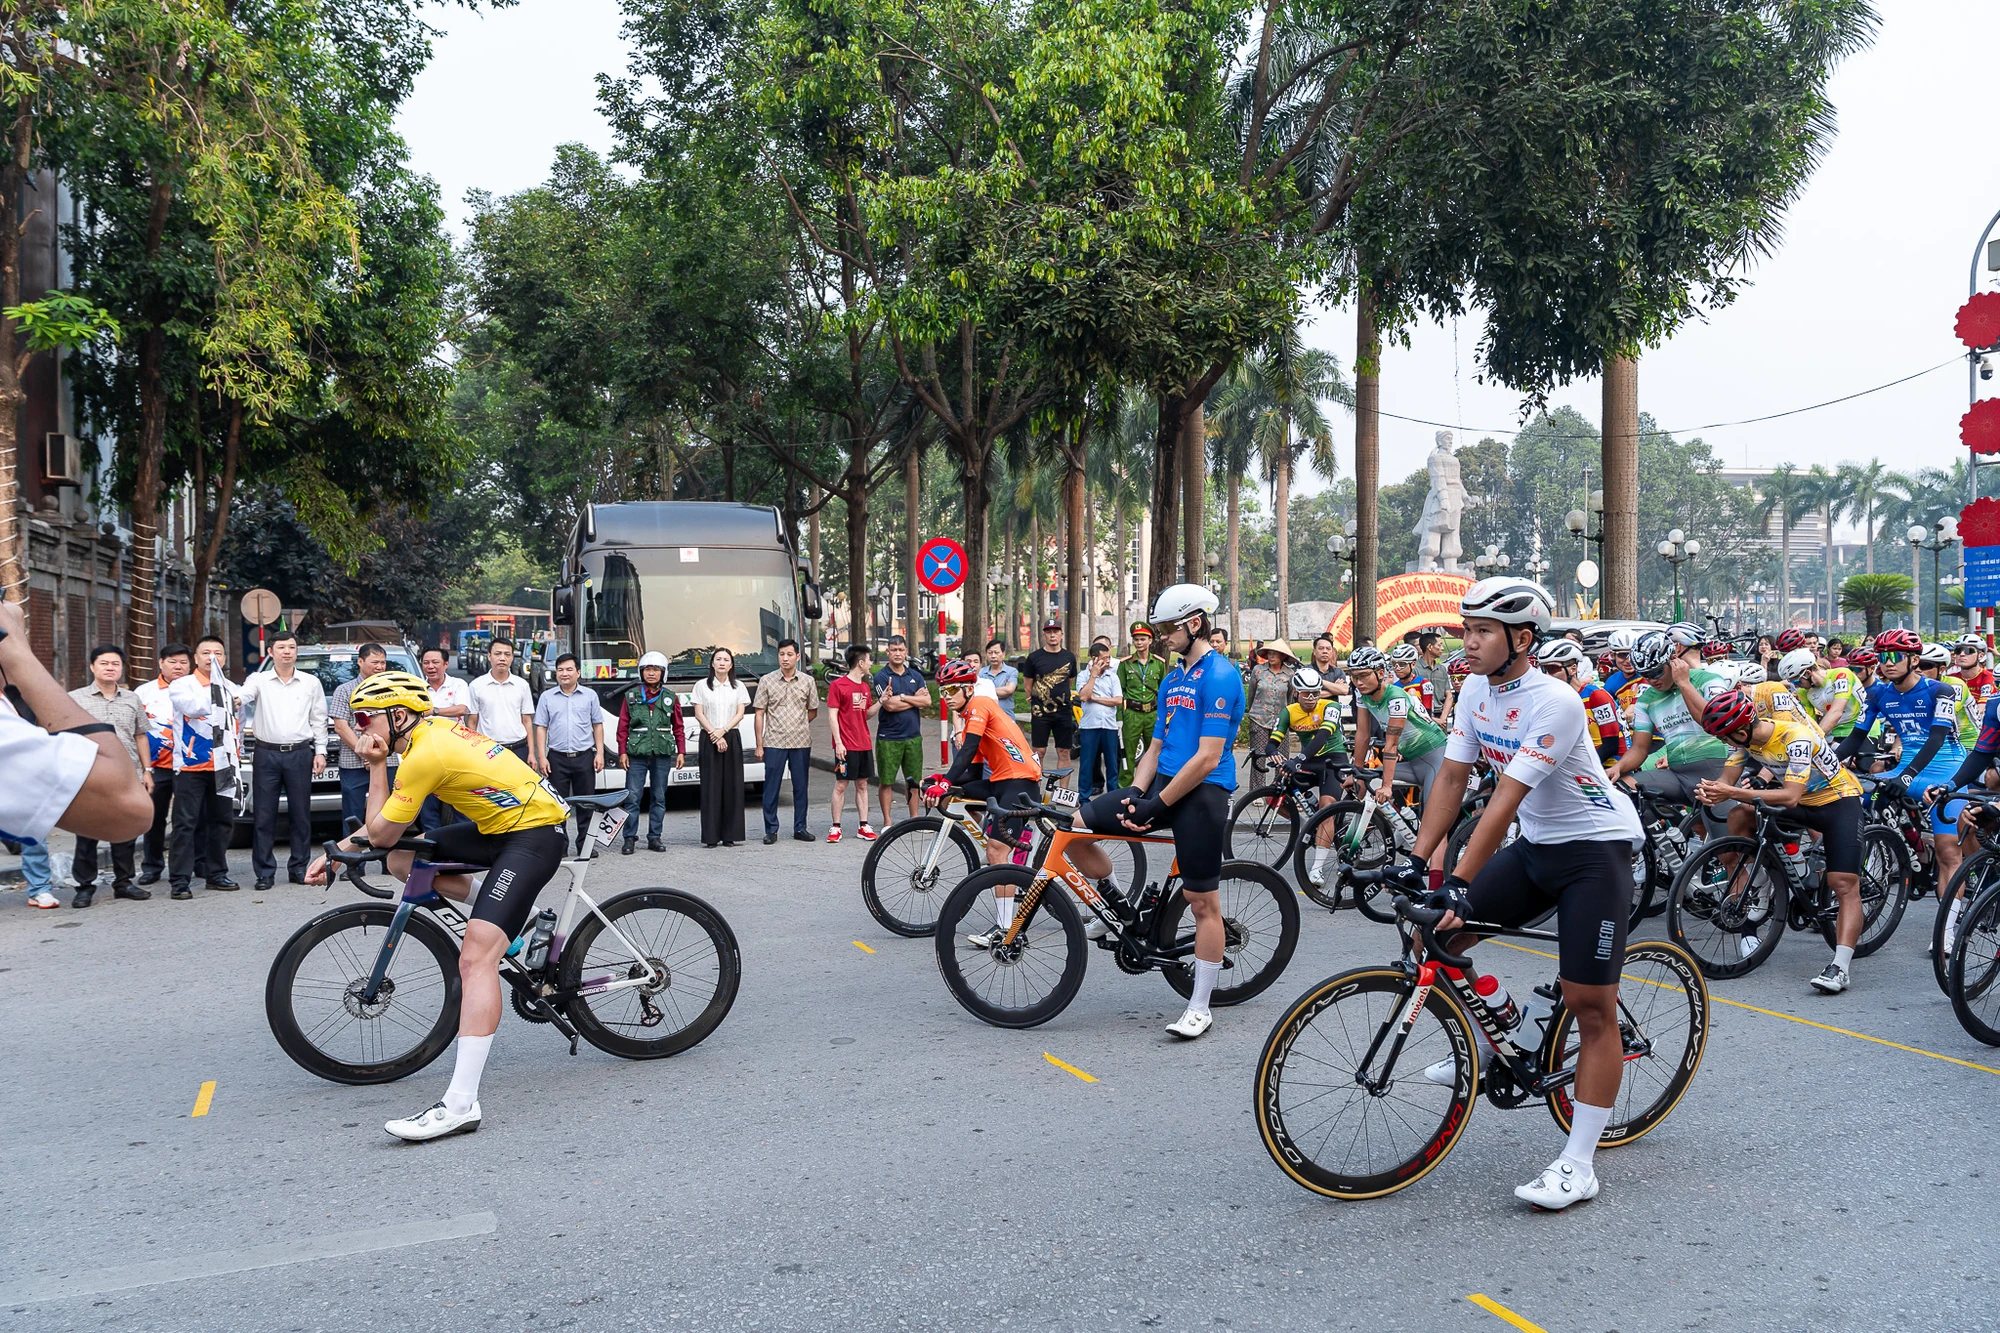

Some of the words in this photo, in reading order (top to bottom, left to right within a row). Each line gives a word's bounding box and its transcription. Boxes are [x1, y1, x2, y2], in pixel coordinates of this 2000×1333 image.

[1498, 679, 1521, 693] HTV
[1394, 701, 1401, 712] 5
[1596, 707, 1611, 722] 35
[1940, 702, 1954, 714] 75
[469, 786, 523, 809] HTV
[1056, 788, 1076, 803] 156
[599, 812, 618, 835] 87
[488, 868, 517, 901] LAMEDA
[1065, 871, 1125, 936] ORBEA
[1594, 920, 1616, 961] LAMEDA
[1445, 1017, 1471, 1101] BORA
[1267, 982, 1360, 1166] CAMPAGNOLO
[1424, 1102, 1465, 1165] ONE
